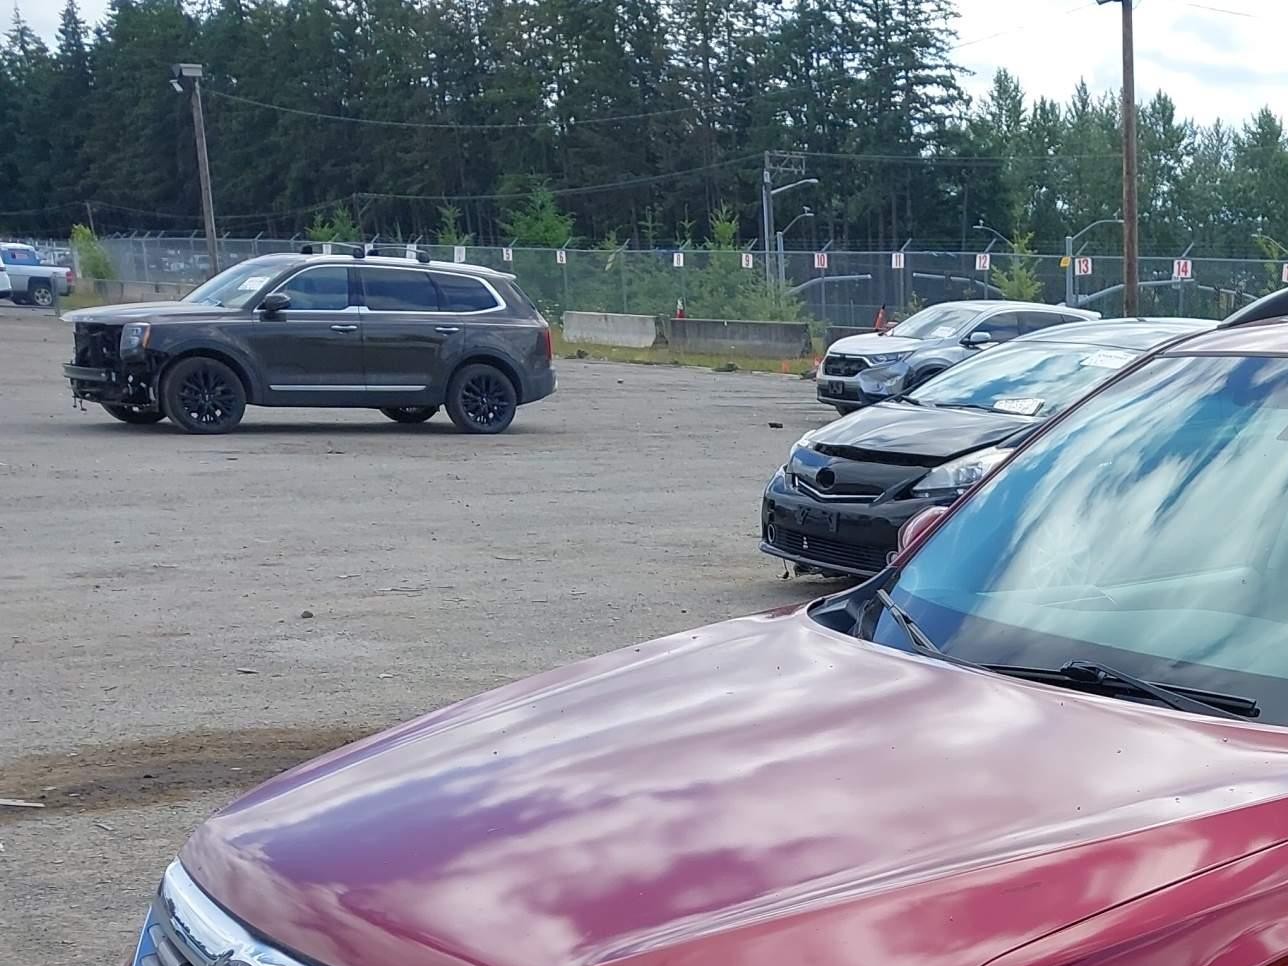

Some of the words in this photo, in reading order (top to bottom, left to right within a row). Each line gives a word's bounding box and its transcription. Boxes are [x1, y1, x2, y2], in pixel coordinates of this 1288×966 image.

[745, 255, 750, 266] 9
[817, 254, 825, 266] 10
[894, 255, 902, 266] 11
[979, 256, 988, 268] 12
[1078, 259, 1089, 273] 13
[1177, 261, 1188, 276] 14
